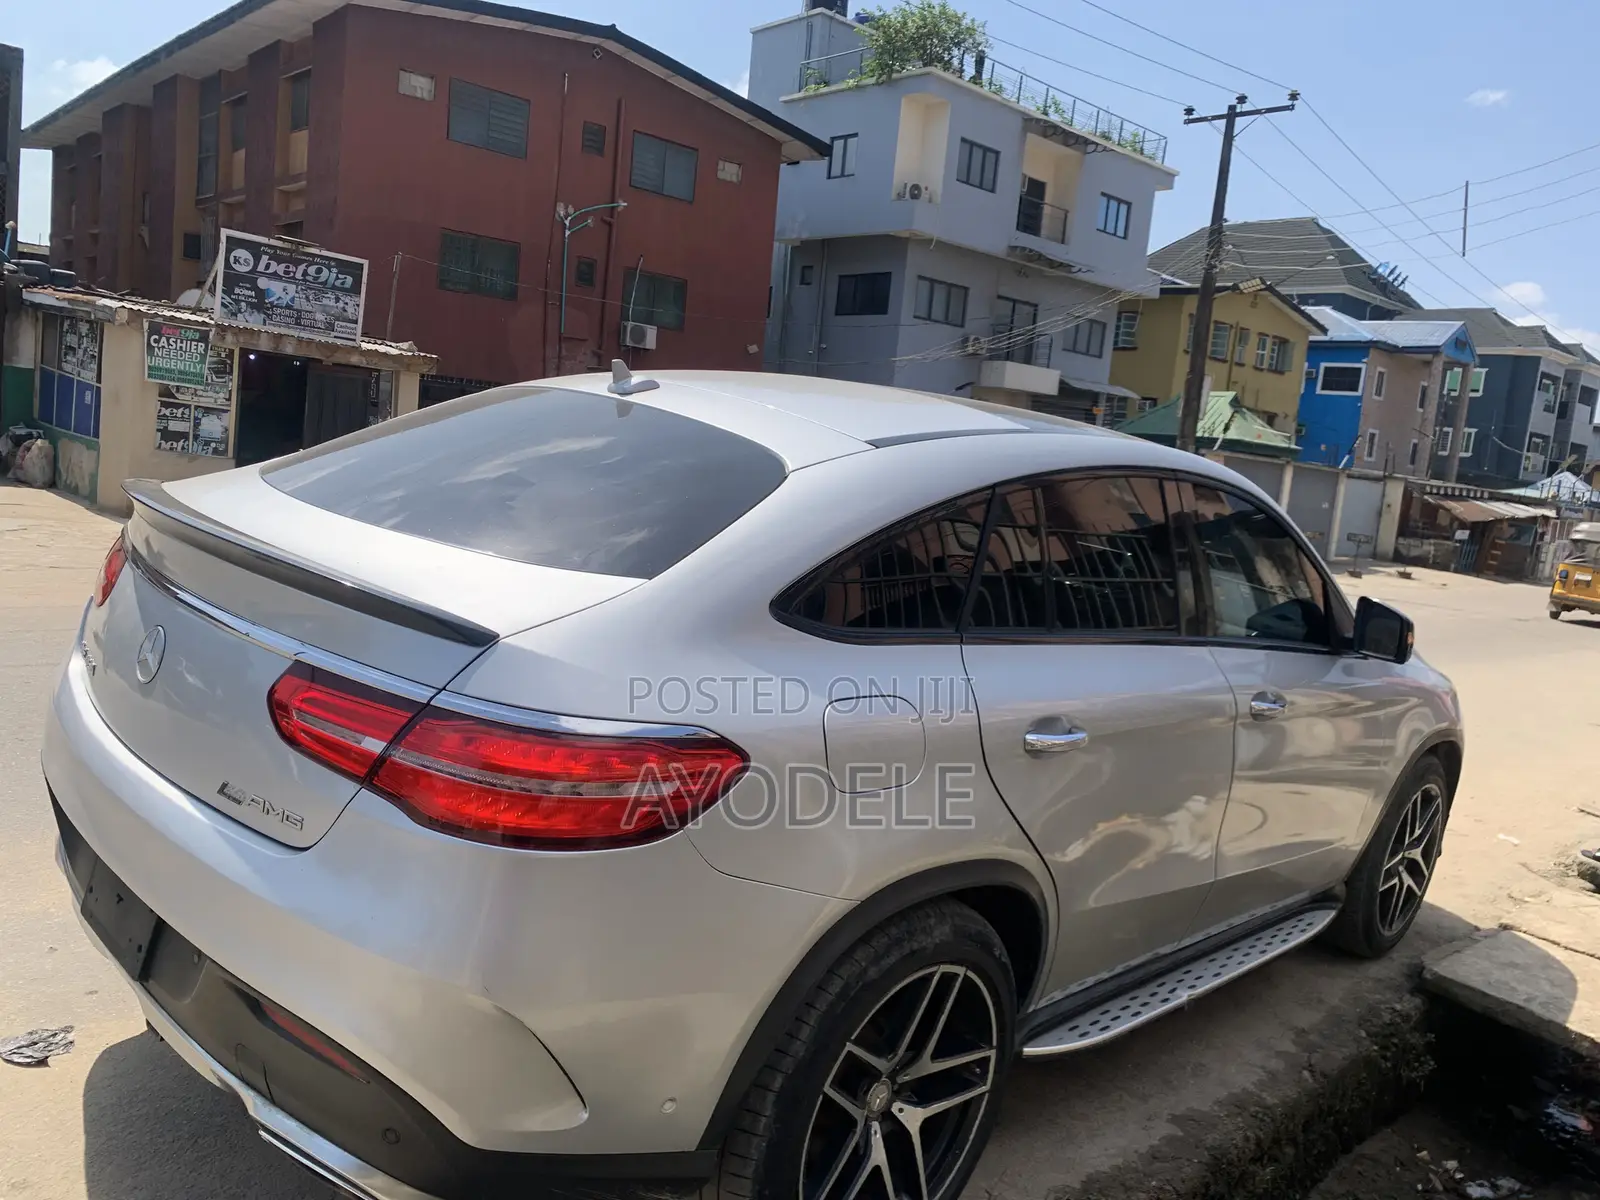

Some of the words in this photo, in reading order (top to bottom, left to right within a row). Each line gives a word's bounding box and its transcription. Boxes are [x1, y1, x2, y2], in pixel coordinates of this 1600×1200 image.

[232, 255, 252, 269] KS
[256, 254, 354, 289] bet9ja
[272, 307, 298, 318] SPORTS
[272, 314, 296, 325] CASINO
[150, 334, 206, 354] CASHIER
[154, 347, 200, 362] NEEDED
[147, 356, 206, 373] URGENTLY!
[243, 792, 304, 831] AMG
